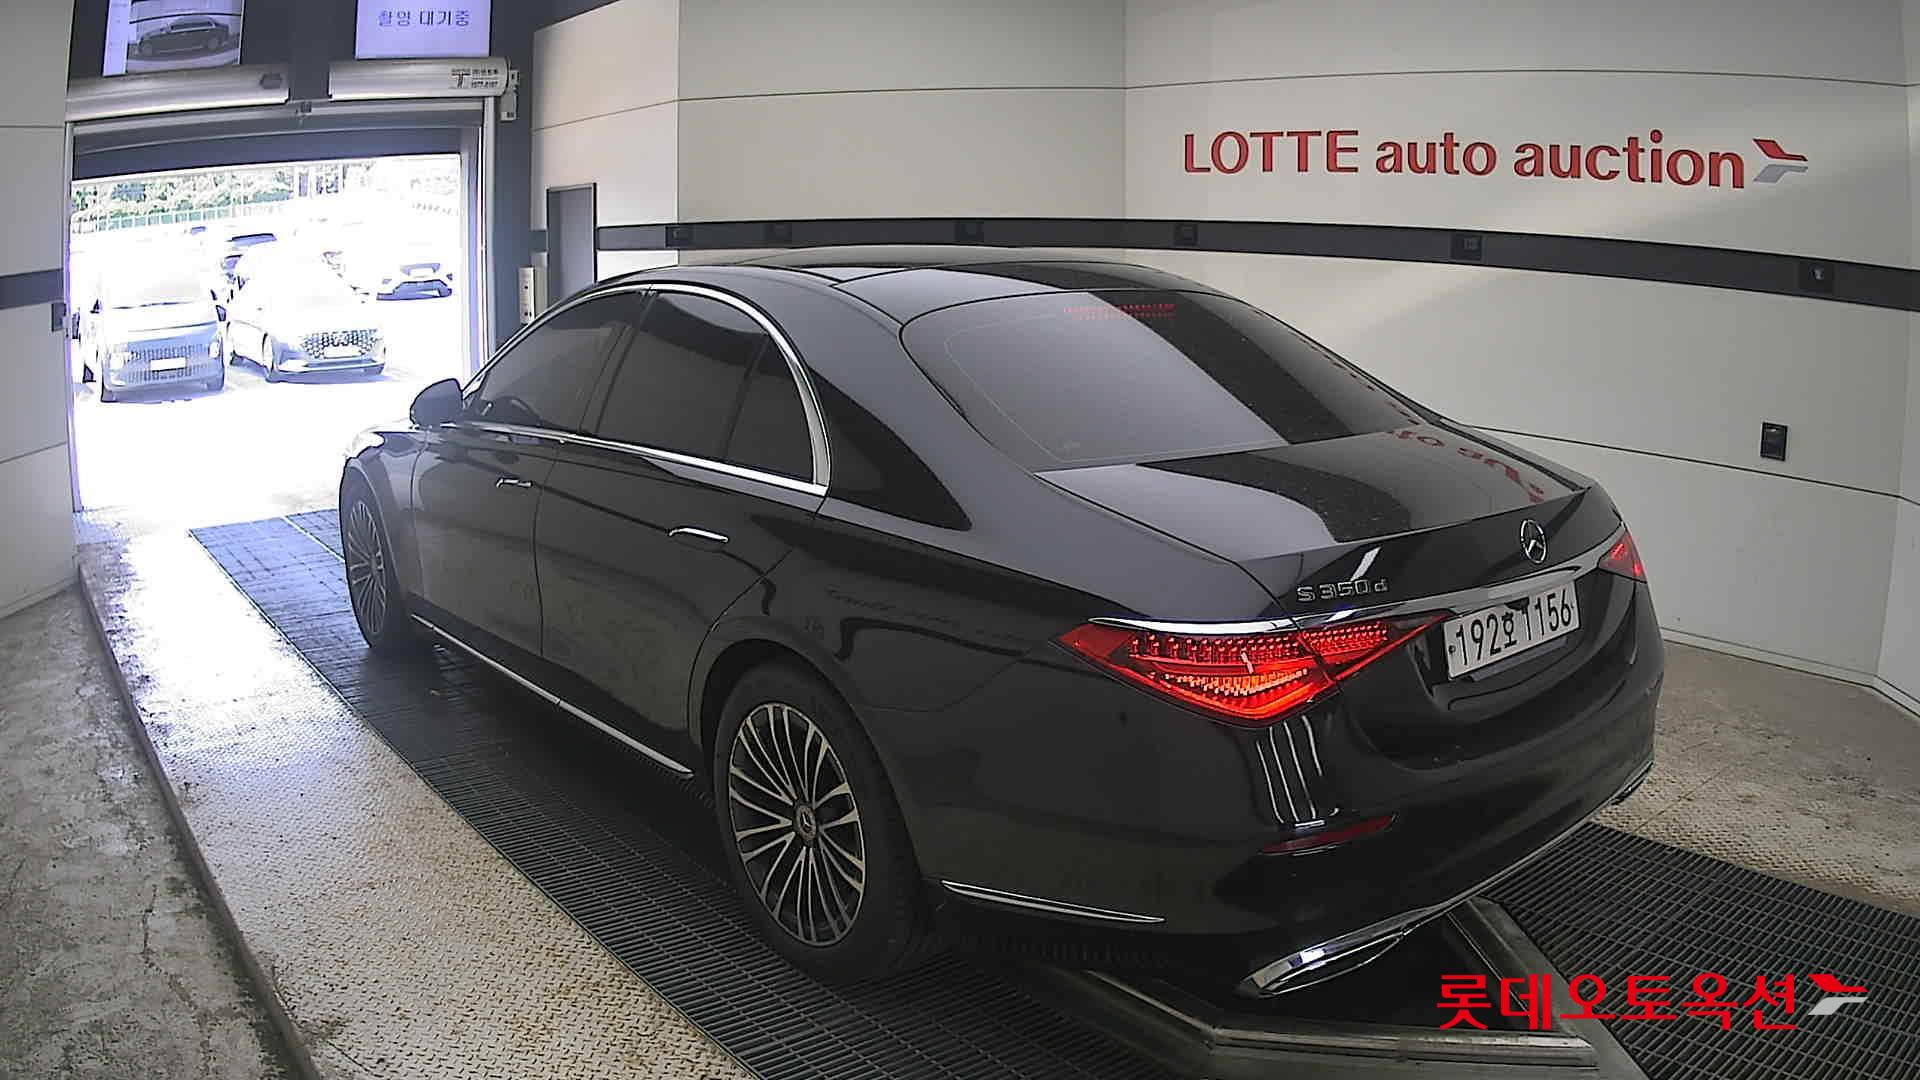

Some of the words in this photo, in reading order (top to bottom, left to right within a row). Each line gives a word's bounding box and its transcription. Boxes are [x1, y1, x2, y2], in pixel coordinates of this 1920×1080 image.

[419, 10, 470, 27] 대기중
[1184, 130, 1359, 174] LOTTE
[1375, 131, 1497, 177] auto
[1513, 129, 1744, 189] auction
